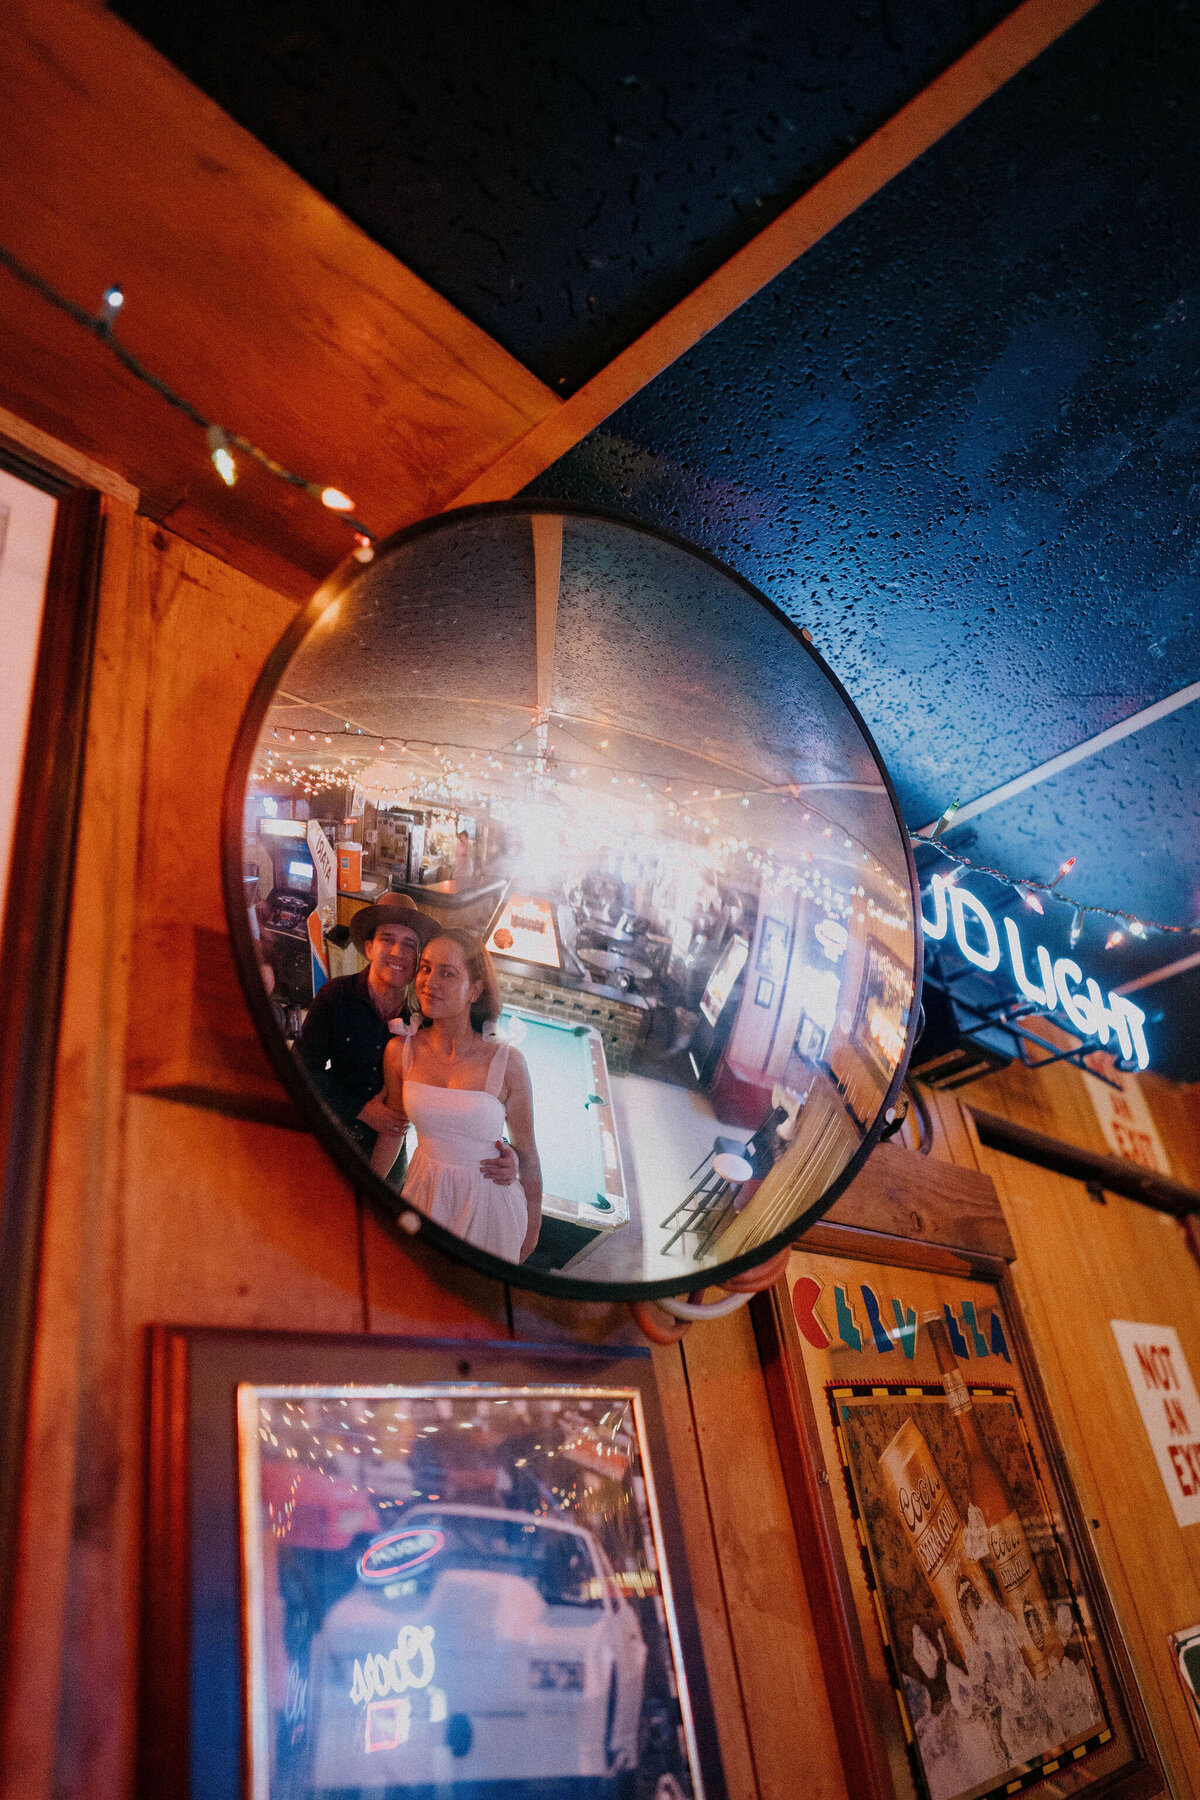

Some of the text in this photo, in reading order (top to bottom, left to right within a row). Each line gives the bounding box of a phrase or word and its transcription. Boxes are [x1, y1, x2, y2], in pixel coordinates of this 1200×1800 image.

[1003, 916, 1150, 1070] LIGHT
[792, 1276, 1011, 1364] CERVEZA
[1133, 1342, 1180, 1391] NOT
[1163, 1398, 1192, 1437] AN
